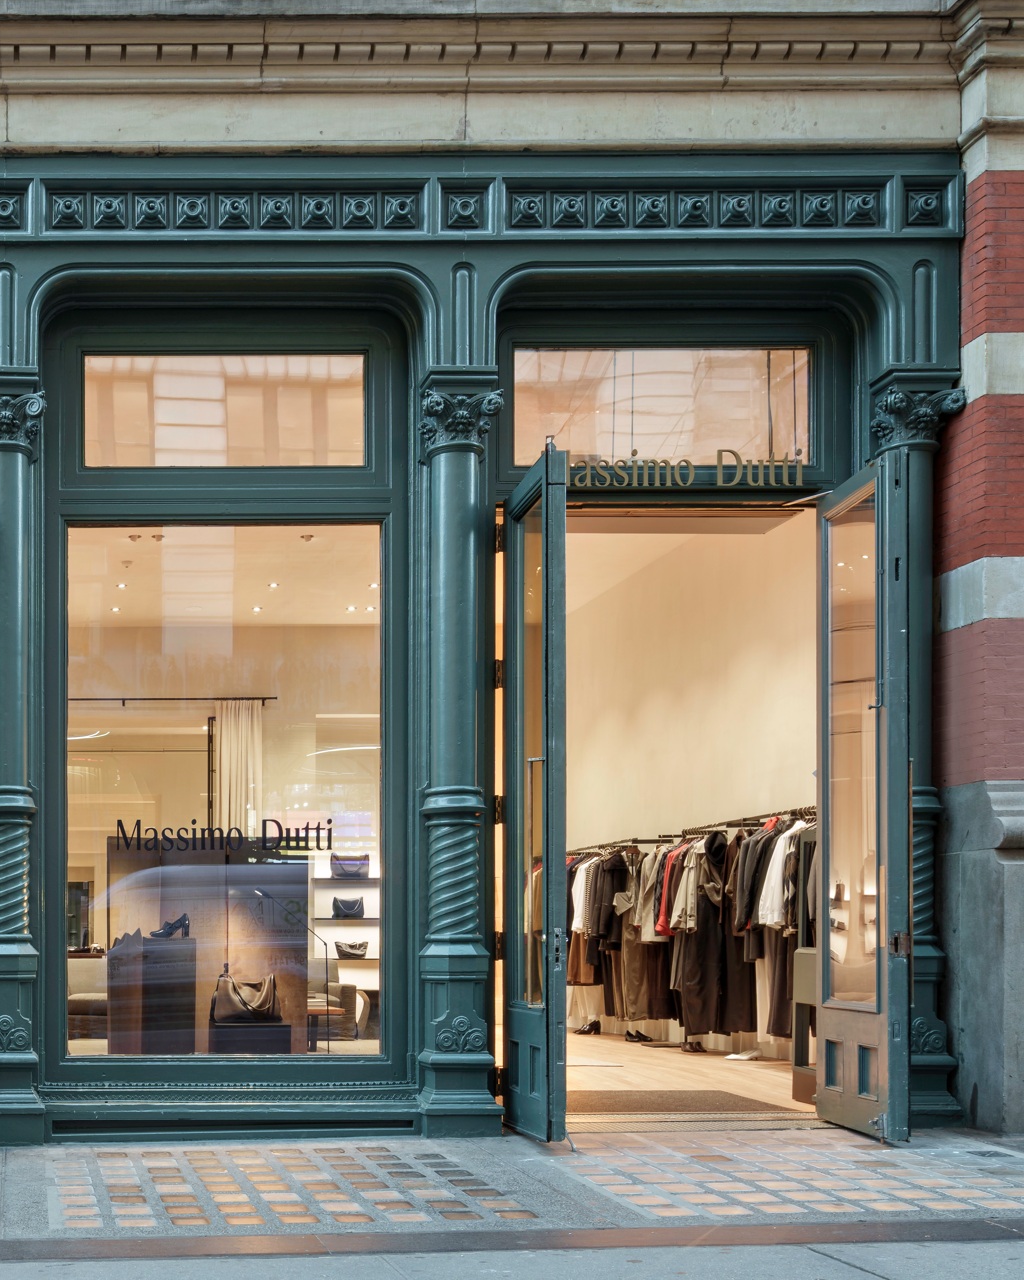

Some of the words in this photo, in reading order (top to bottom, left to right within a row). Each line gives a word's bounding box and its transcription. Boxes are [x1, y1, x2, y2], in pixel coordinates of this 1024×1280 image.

[566, 448, 695, 487] assimo
[716, 448, 804, 487] Dutti
[116, 818, 244, 852] Massimo
[261, 818, 333, 851] Dutti
